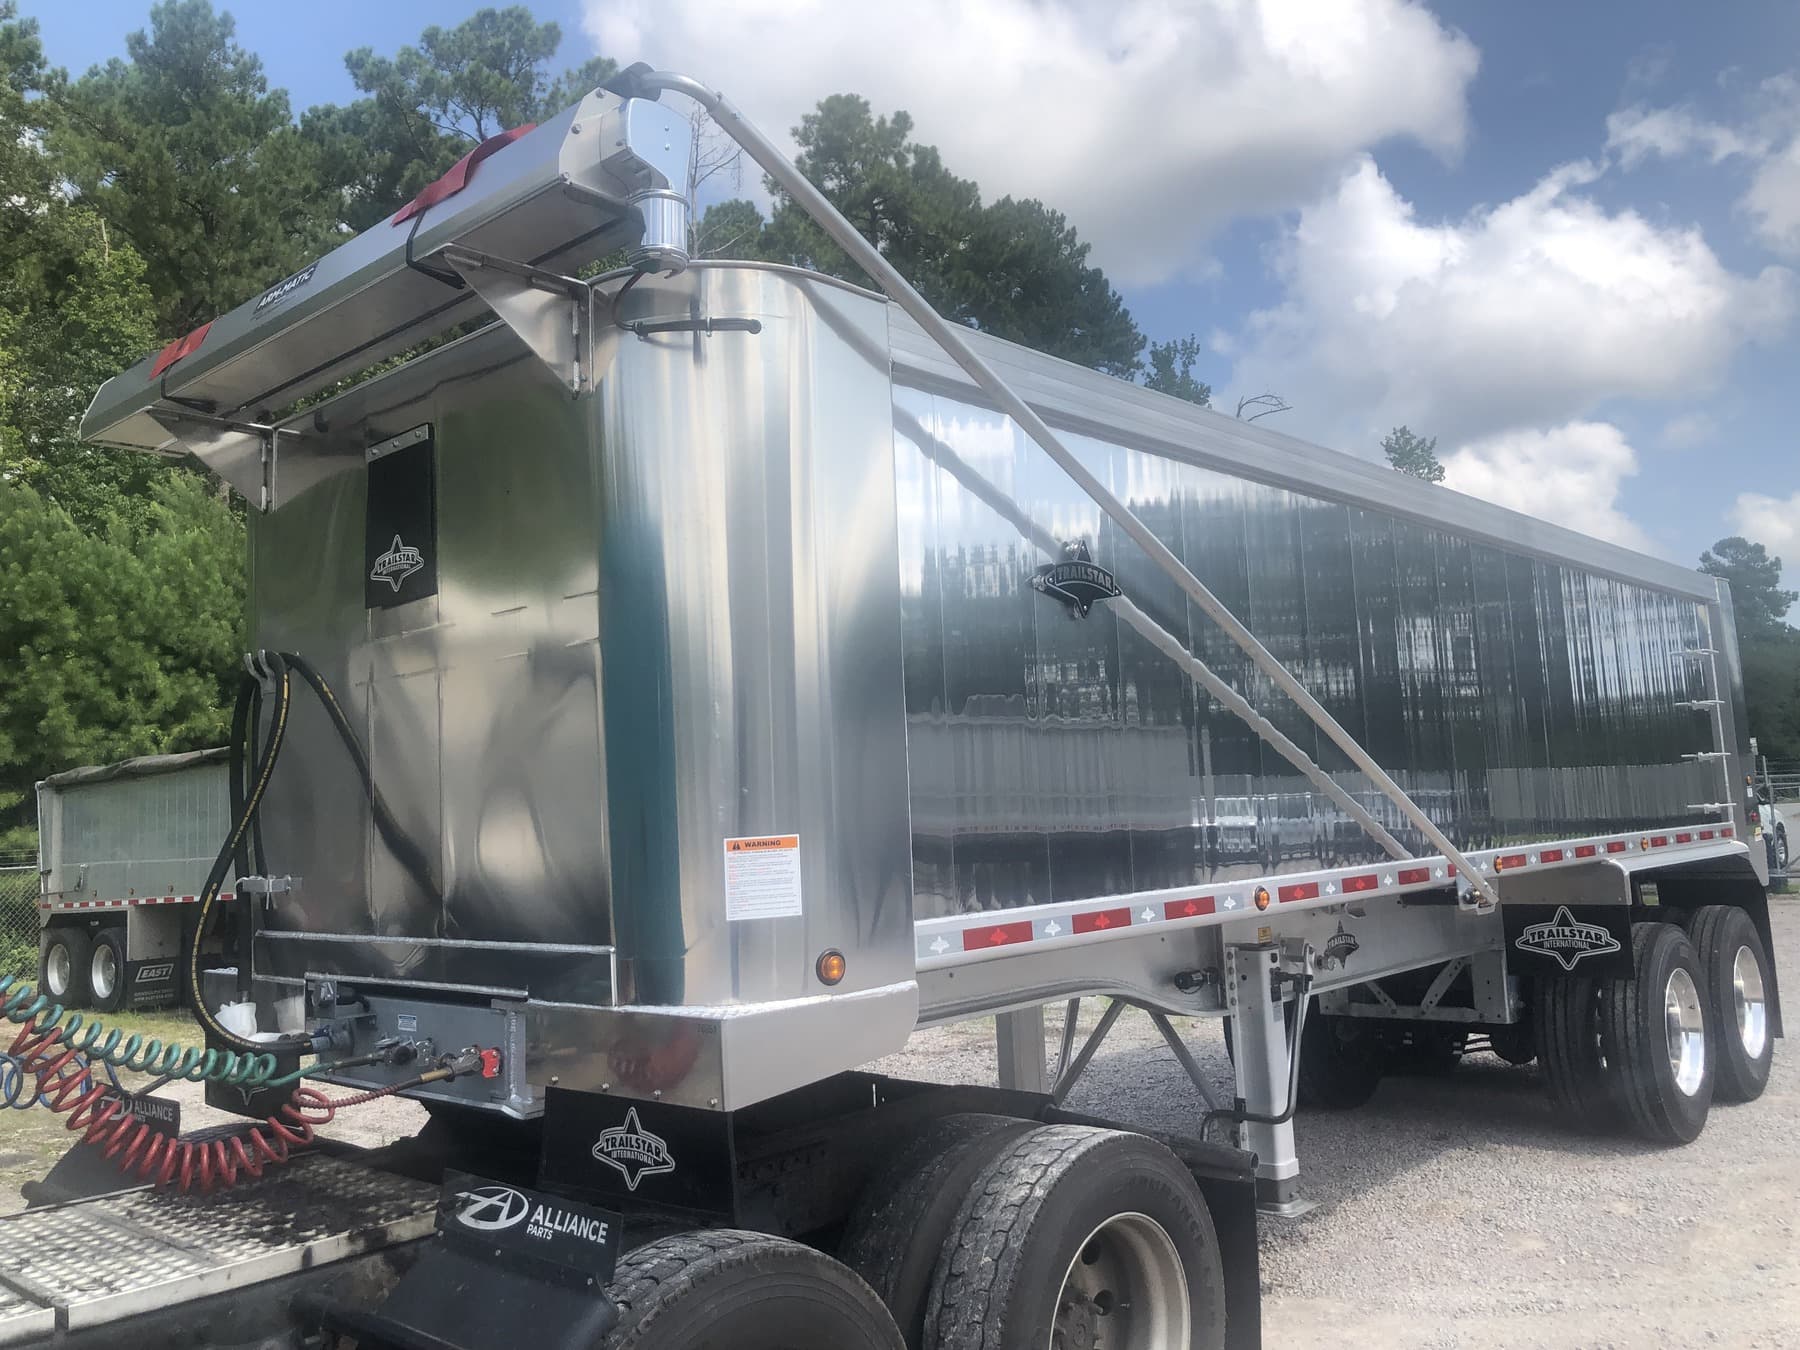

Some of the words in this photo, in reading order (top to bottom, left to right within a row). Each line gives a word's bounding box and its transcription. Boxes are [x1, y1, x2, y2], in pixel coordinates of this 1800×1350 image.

[377, 552, 417, 573] TRAILSTAR
[1056, 565, 1112, 590] TRAILSTAR
[744, 840, 781, 848] WARNING
[1529, 928, 1604, 943] TRAILSTAR
[1543, 940, 1591, 950] INTERNATIONAL
[141, 967, 169, 978] EAST
[134, 1101, 174, 1122] ALLIANCE
[605, 1135, 662, 1160] TRAILSTAR
[611, 1150, 655, 1166] INTERNATIONAL
[526, 1224, 553, 1240] PARTS
[530, 1204, 608, 1244] ALLIANCE
